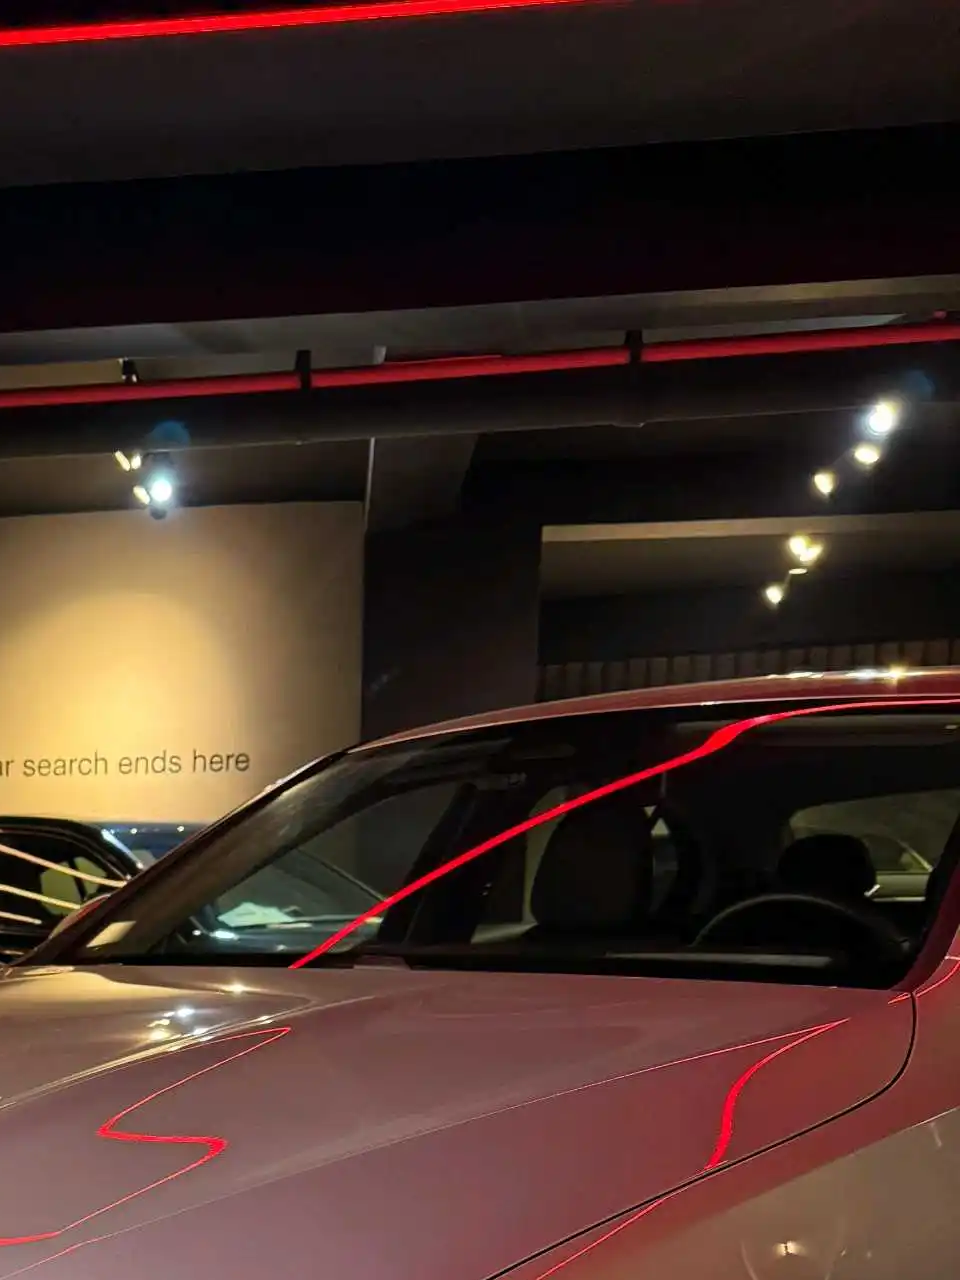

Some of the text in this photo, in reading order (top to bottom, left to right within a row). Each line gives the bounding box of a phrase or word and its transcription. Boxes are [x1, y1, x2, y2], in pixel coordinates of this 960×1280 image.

[23, 751, 108, 777] search
[118, 750, 182, 774] ends
[192, 749, 251, 773] here
